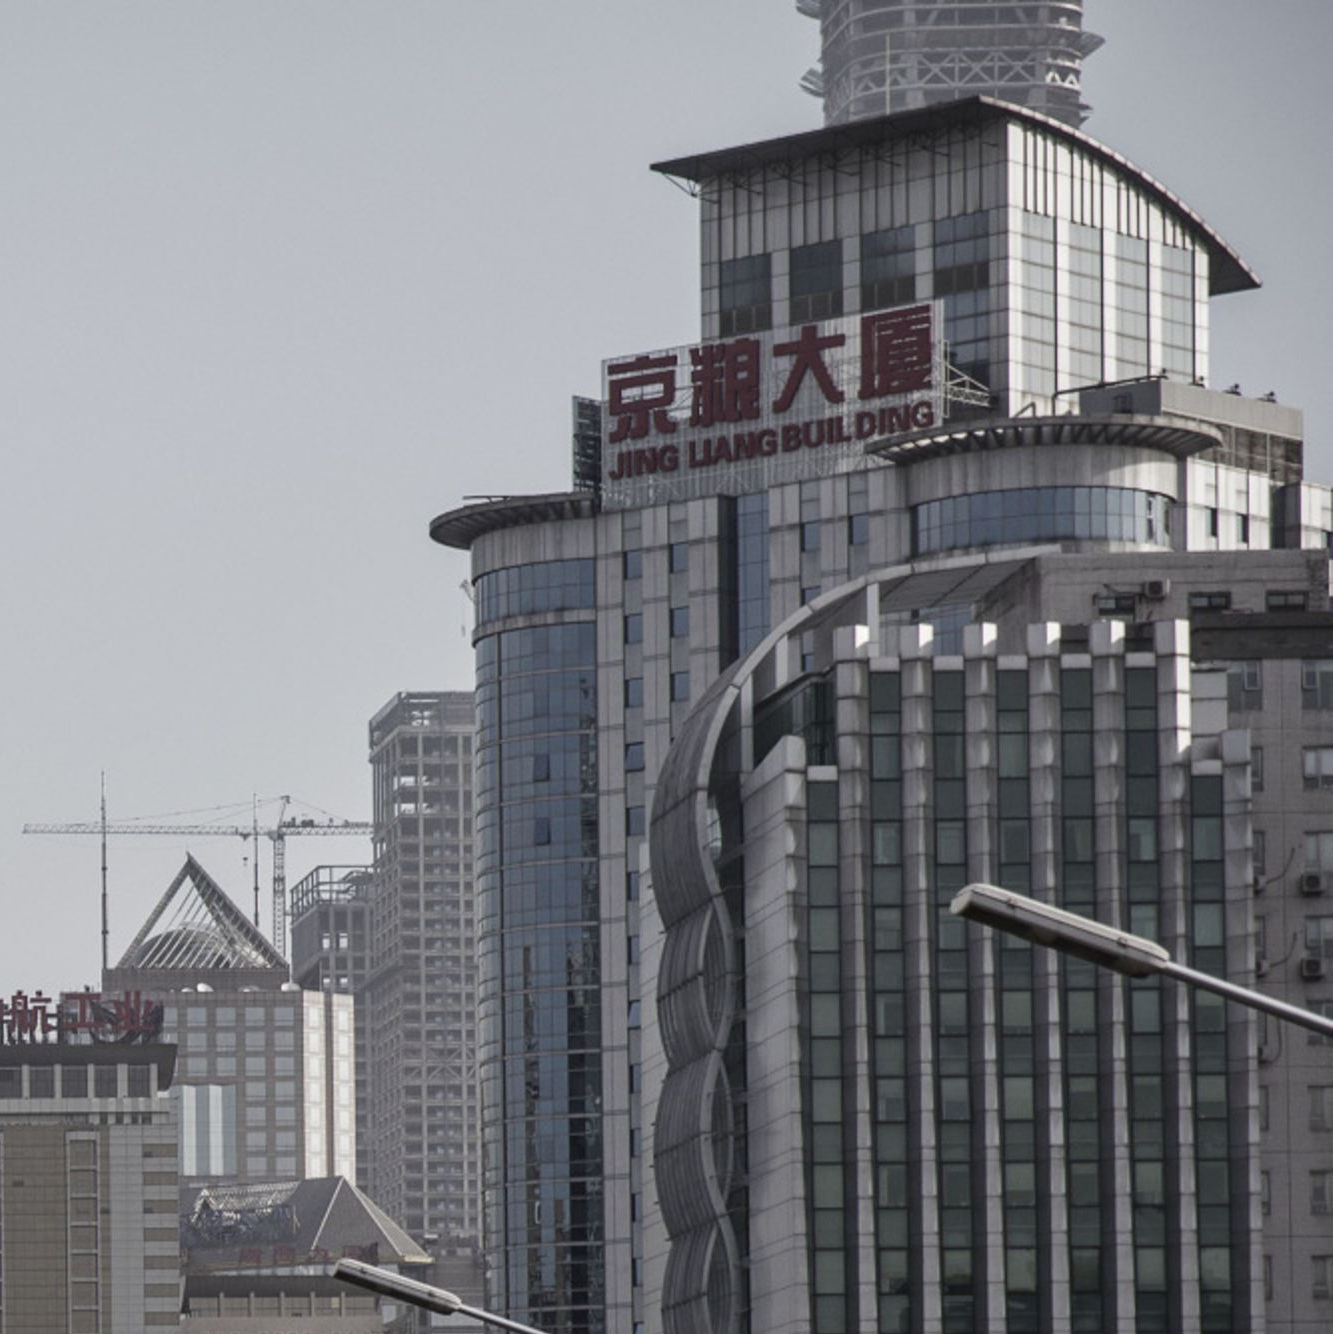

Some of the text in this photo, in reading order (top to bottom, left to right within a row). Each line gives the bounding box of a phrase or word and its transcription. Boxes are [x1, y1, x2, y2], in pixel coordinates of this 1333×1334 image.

[607, 304, 933, 444] 京粮大厦
[608, 445, 679, 480] JING
[688, 429, 777, 468] LIANG
